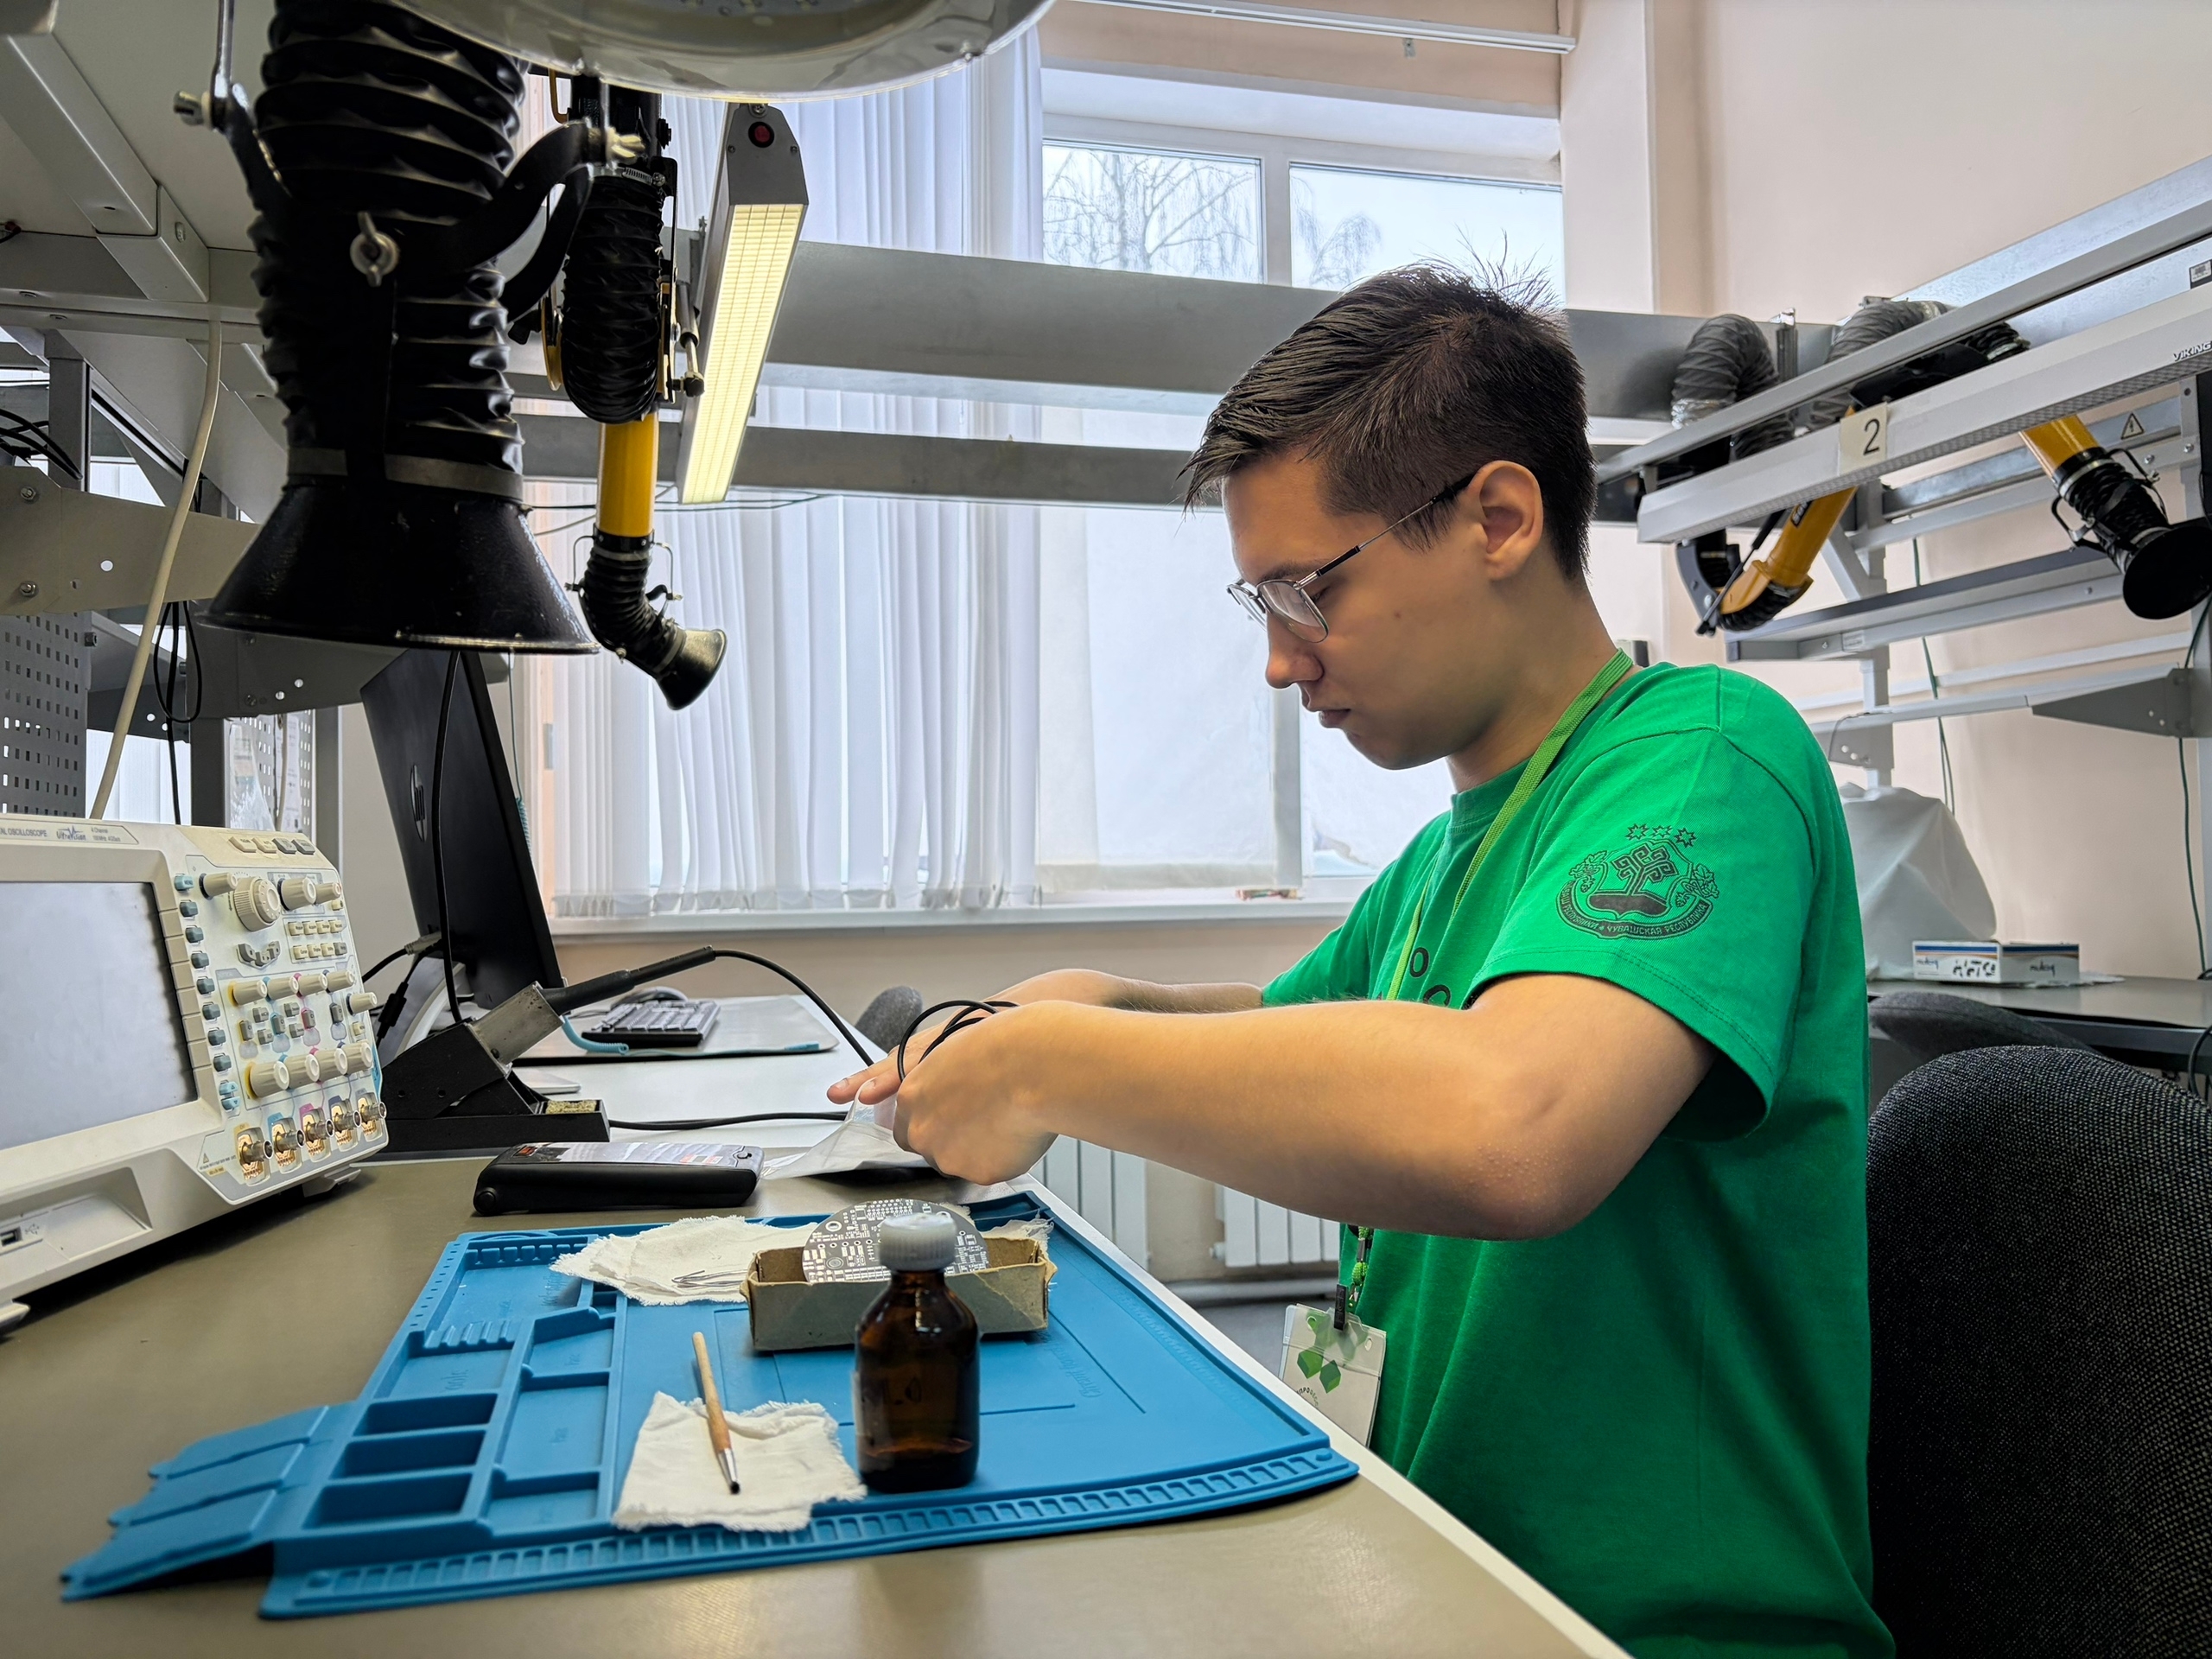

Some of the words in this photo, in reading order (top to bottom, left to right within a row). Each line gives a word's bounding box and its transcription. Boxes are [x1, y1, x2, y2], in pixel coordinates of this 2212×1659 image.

[2172, 340, 2212, 362] VIKING
[1863, 418, 1880, 456] 2
[8, 828, 48, 837] OSCILLOSCOPE
[1606, 925, 1662, 936] ЧУВАШСКАЯ
[1665, 903, 1708, 933] РЕСПУБЛИКА
